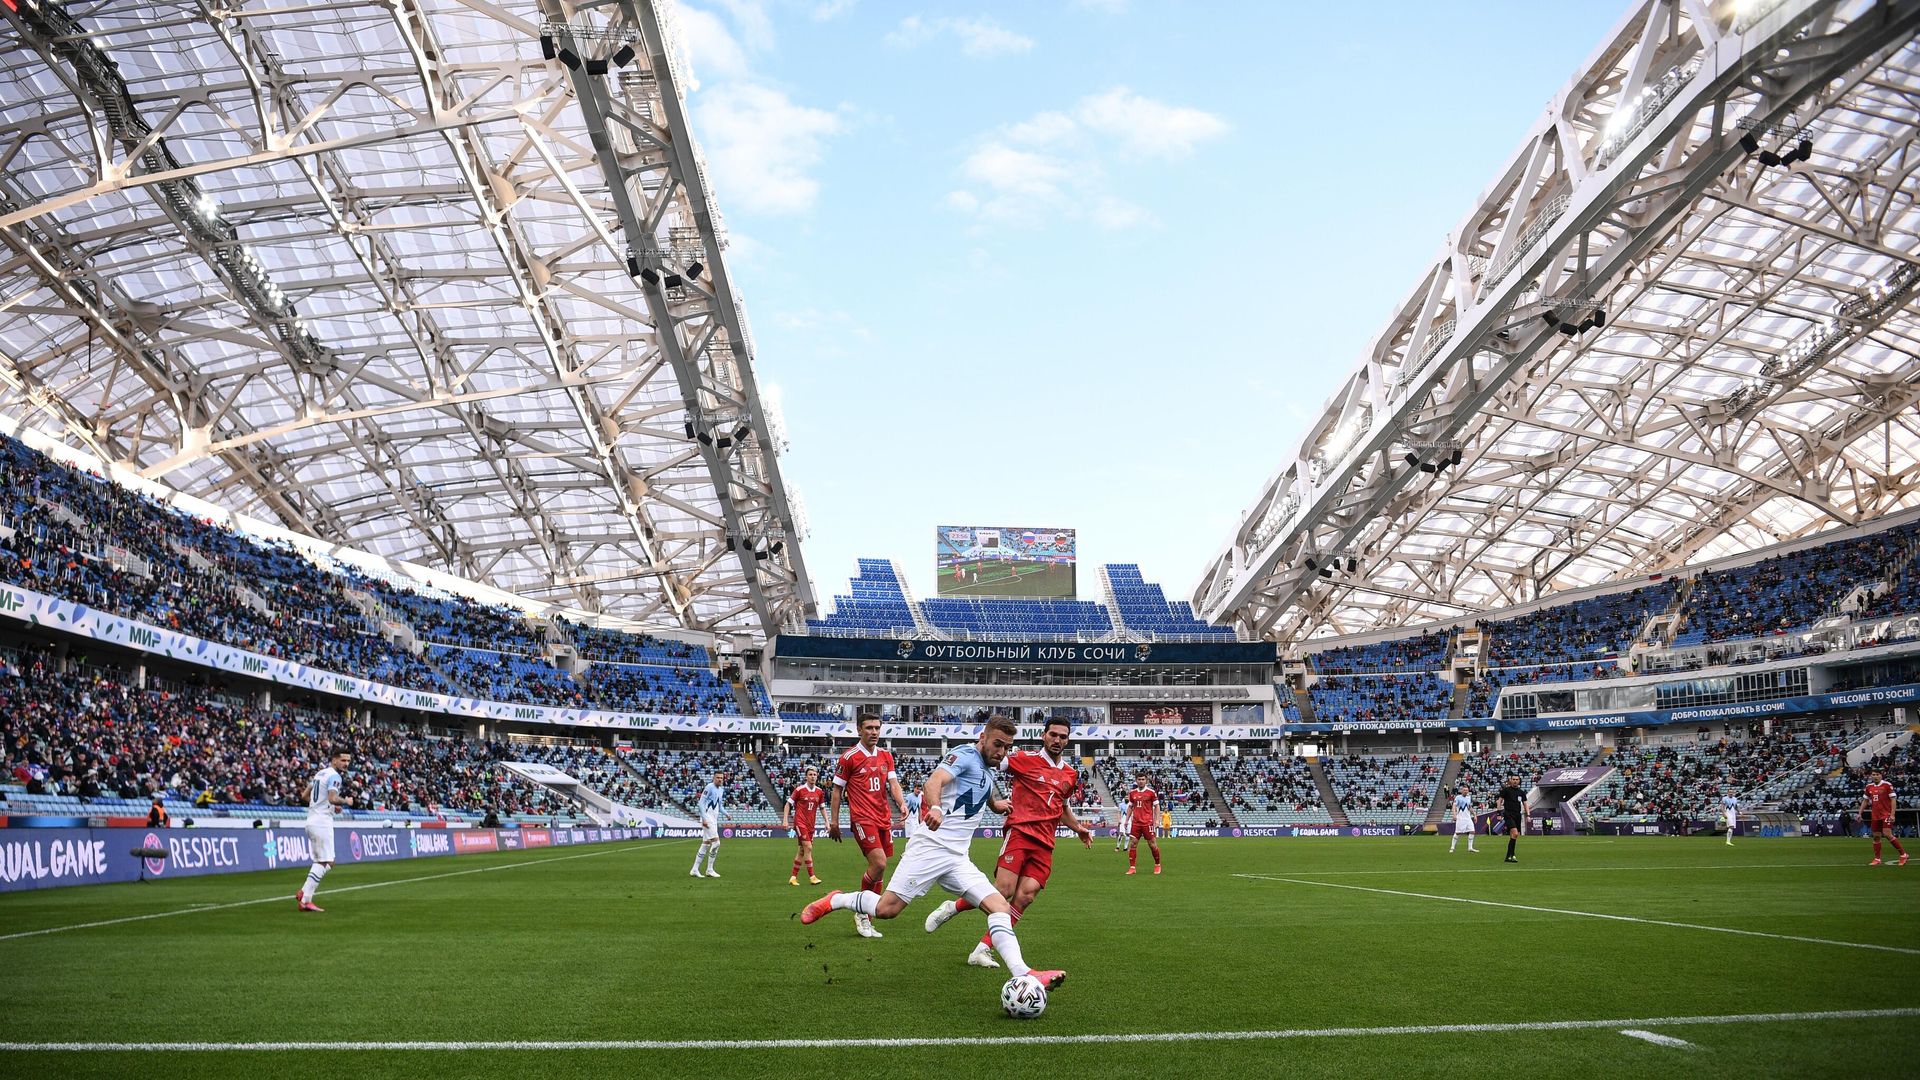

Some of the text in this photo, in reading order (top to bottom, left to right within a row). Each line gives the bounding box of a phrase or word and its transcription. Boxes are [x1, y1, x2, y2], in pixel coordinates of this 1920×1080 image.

[0, 588, 25, 612] ИР
[130, 625, 162, 648] МИР
[925, 644, 1125, 660] ФУТБОЛЬНЫЙ КЛУБ СОЧИ
[243, 655, 269, 674] МИР
[334, 677, 356, 694] МИР
[415, 694, 440, 709] МИР
[1830, 688, 1916, 705] WELCOME TO SOCHI!
[515, 707, 545, 720] МИР
[1671, 702, 1785, 720] ДОБРО ПОЖАЛОВАТЬ В СОЧИ!
[629, 715, 660, 727] МИР
[749, 721, 781, 731] МИР
[1332, 723, 1359, 731] ДОБРО
[1360, 721, 1415, 730] ПОЖАЛОВАТЬ
[1548, 719, 1586, 728] WELCOME
[1599, 716, 1626, 725] SOCHI!
[790, 724, 821, 734] МИР
[906, 727, 937, 737] МИР
[1022, 728, 1043, 738] МИ
[1134, 728, 1164, 738] МИР
[1249, 728, 1280, 738] МИР
[868, 777, 881, 792] 18
[1047, 790, 1056, 806] 7
[1136, 800, 1142, 808] 11
[807, 802, 815, 811] 17
[735, 829, 773, 838] RESPECT
[1243, 828, 1278, 837] RESPECT
[1362, 828, 1396, 836] RESPECT
[361, 834, 398, 857] RESPECT
[169, 837, 240, 869] RESPECT
